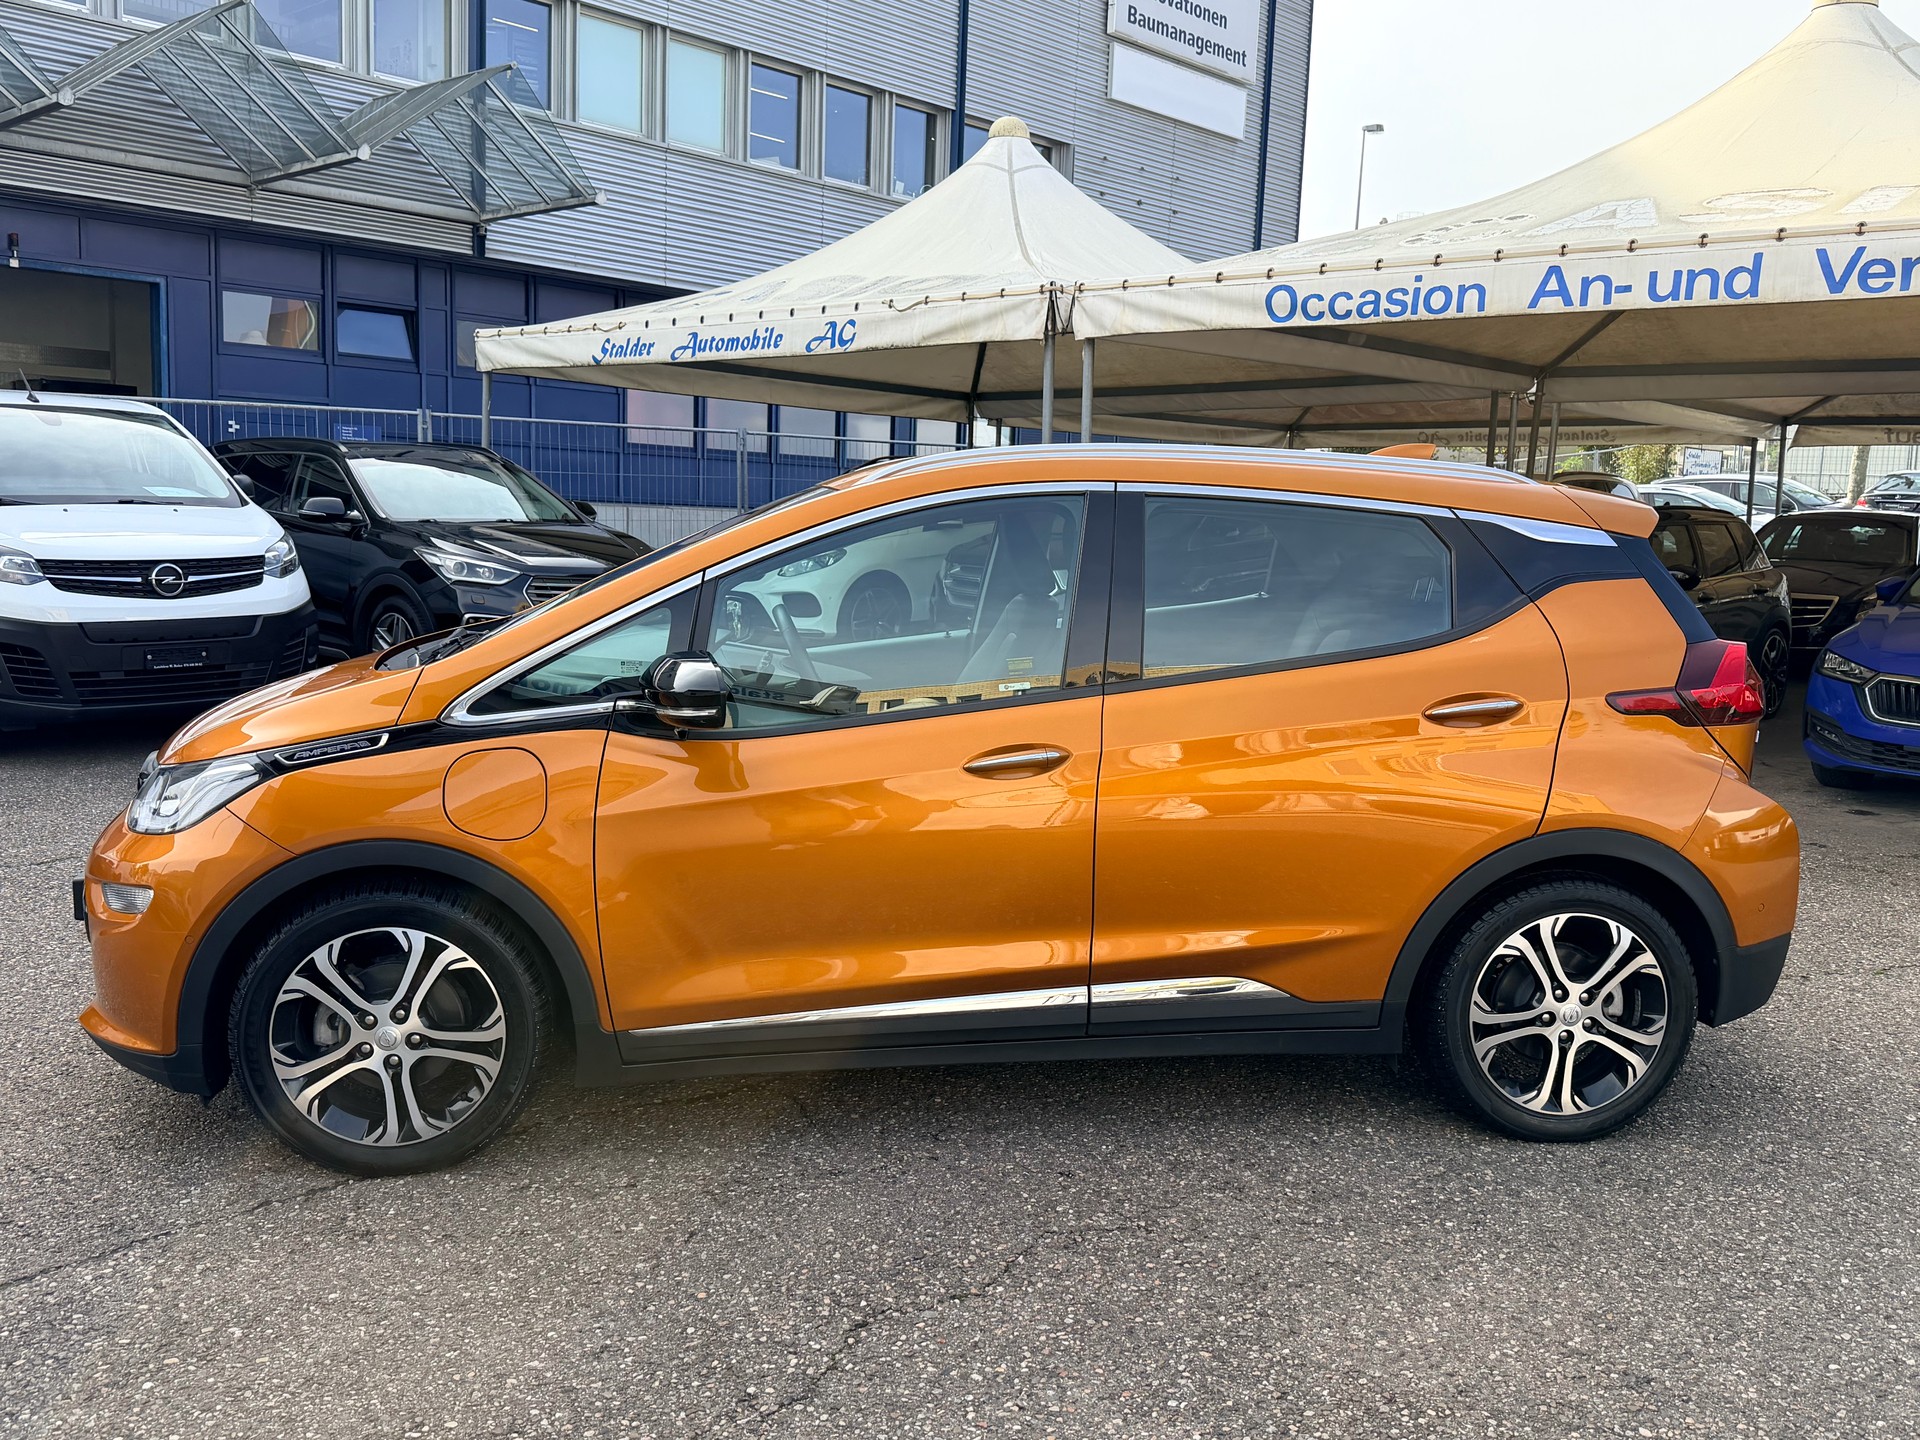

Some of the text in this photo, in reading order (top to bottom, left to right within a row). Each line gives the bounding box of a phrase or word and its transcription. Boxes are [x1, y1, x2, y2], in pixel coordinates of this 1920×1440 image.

[1127, 4, 1247, 67] Baumanagement
[1154, 0, 1228, 29] vationen
[1265, 275, 1487, 323] Occasion
[1527, 265, 1632, 308] An-
[1647, 252, 1764, 302] und
[592, 318, 857, 365] Stalder Automobile AG
